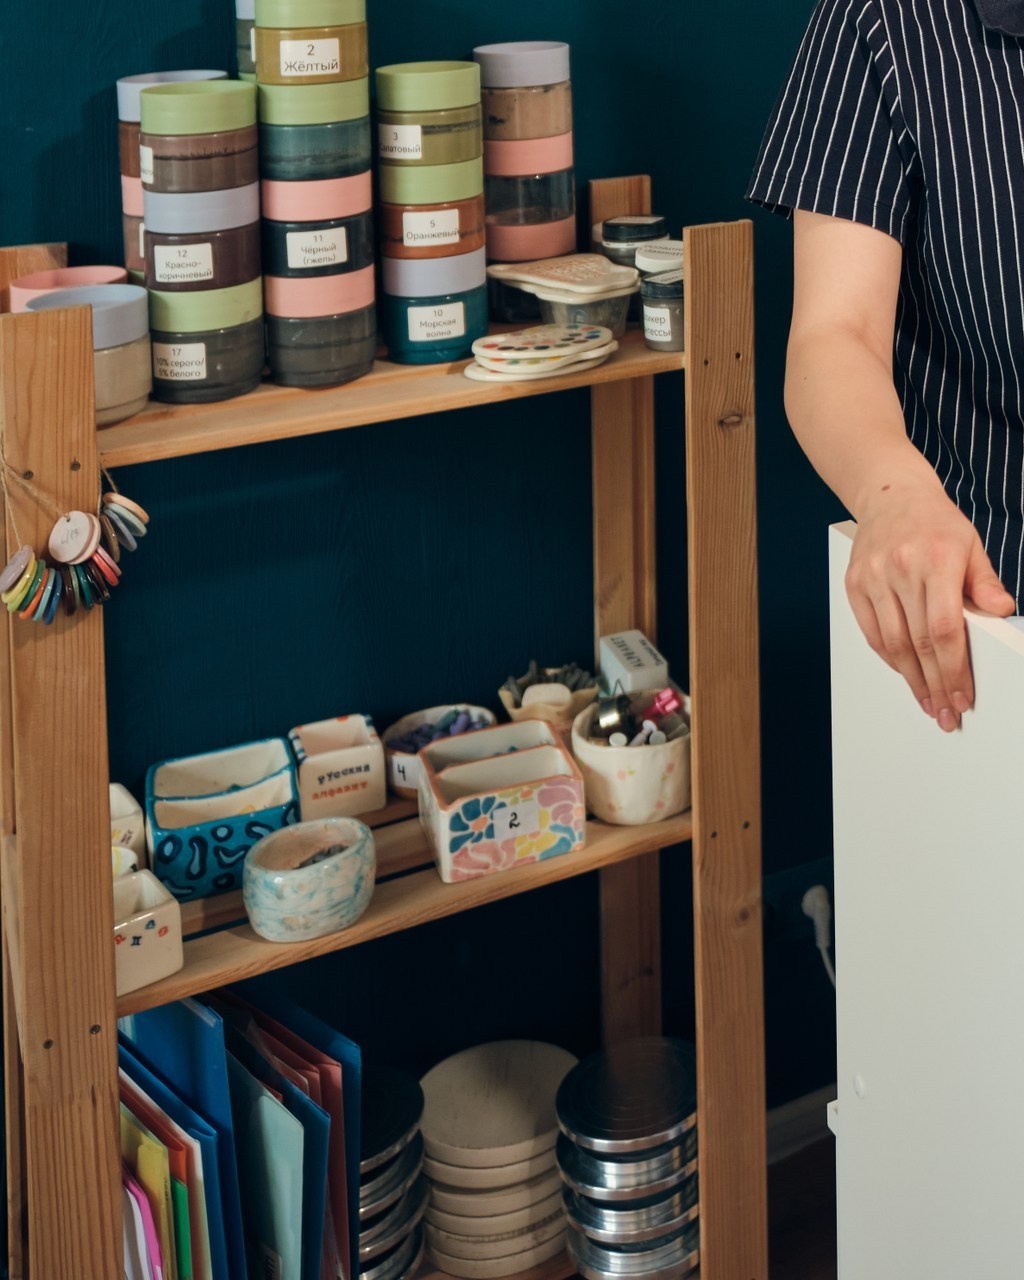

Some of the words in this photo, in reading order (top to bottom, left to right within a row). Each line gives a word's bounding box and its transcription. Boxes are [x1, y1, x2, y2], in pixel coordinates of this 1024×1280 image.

[307, 44, 315, 56] 2
[284, 59, 339, 72] Жёлтый
[393, 132, 398, 141] 3
[429, 220, 436, 229] 5
[313, 234, 323, 243] 11
[406, 228, 460, 241] Оранжевый
[177, 249, 188, 258] 12
[303, 253, 336, 266] (гжель)
[165, 260, 201, 270] Красно-
[159, 268, 212, 280] коричневый
[433, 309, 443, 317] 10
[419, 318, 456, 328] Морская
[426, 329, 452, 338] волна
[172, 348, 181, 356] 17
[170, 368, 201, 378] белого
[397, 763, 406, 781] 4
[509, 812, 520, 829] 2
